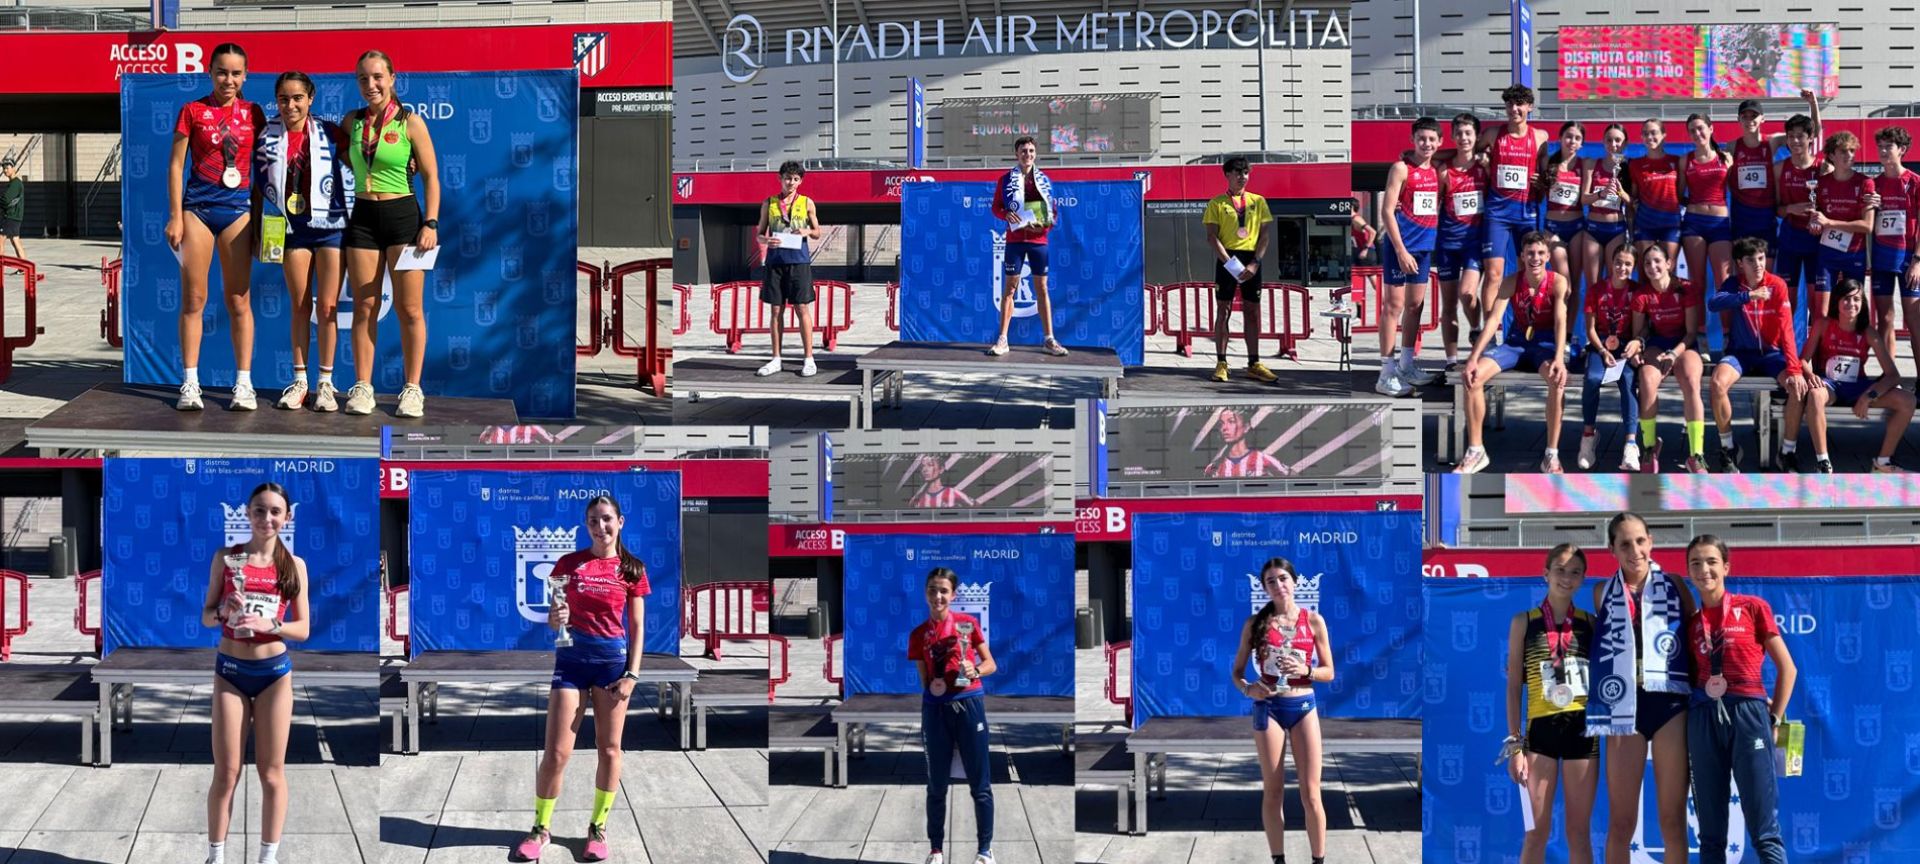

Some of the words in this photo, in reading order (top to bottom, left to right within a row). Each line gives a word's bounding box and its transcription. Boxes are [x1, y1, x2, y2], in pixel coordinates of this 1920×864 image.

[785, 19, 945, 64] RIYADH
[961, 15, 1040, 55] AIR
[1056, 9, 1352, 50] METROPOLITA
[1522, 29, 1530, 66] B
[110, 44, 168, 61] ACCESO
[174, 43, 204, 74] B
[1564, 51, 1623, 63] DISFRUTA
[1626, 50, 1672, 63] GRATIS
[1564, 66, 1594, 78] ESTE
[1595, 66, 1633, 78] FINAL
[1636, 65, 1651, 78] DE
[597, 92, 621, 101] ACCESO
[622, 91, 665, 101] EXPERIENCIA
[611, 104, 640, 112] PRE-MATCH
[915, 101, 922, 128] B
[1505, 172, 1519, 182] 50
[1745, 172, 1759, 182] 49
[1557, 188, 1571, 198] 39
[1422, 199, 1432, 208] 52
[1462, 198, 1476, 208] 56
[1882, 218, 1897, 228] 57
[1828, 230, 1842, 243] 54
[1834, 363, 1851, 375] 47
[1099, 410, 1106, 446] B
[274, 461, 335, 473] MADRID
[826, 455, 832, 482] B
[390, 468, 408, 491] B
[1105, 507, 1126, 533] B
[795, 530, 827, 540] ACCESO
[831, 529, 846, 550] B
[1299, 532, 1358, 544] MADRID
[797, 541, 827, 550] ACCESS
[973, 550, 1020, 560] MADRID
[1551, 667, 1587, 686] 11
